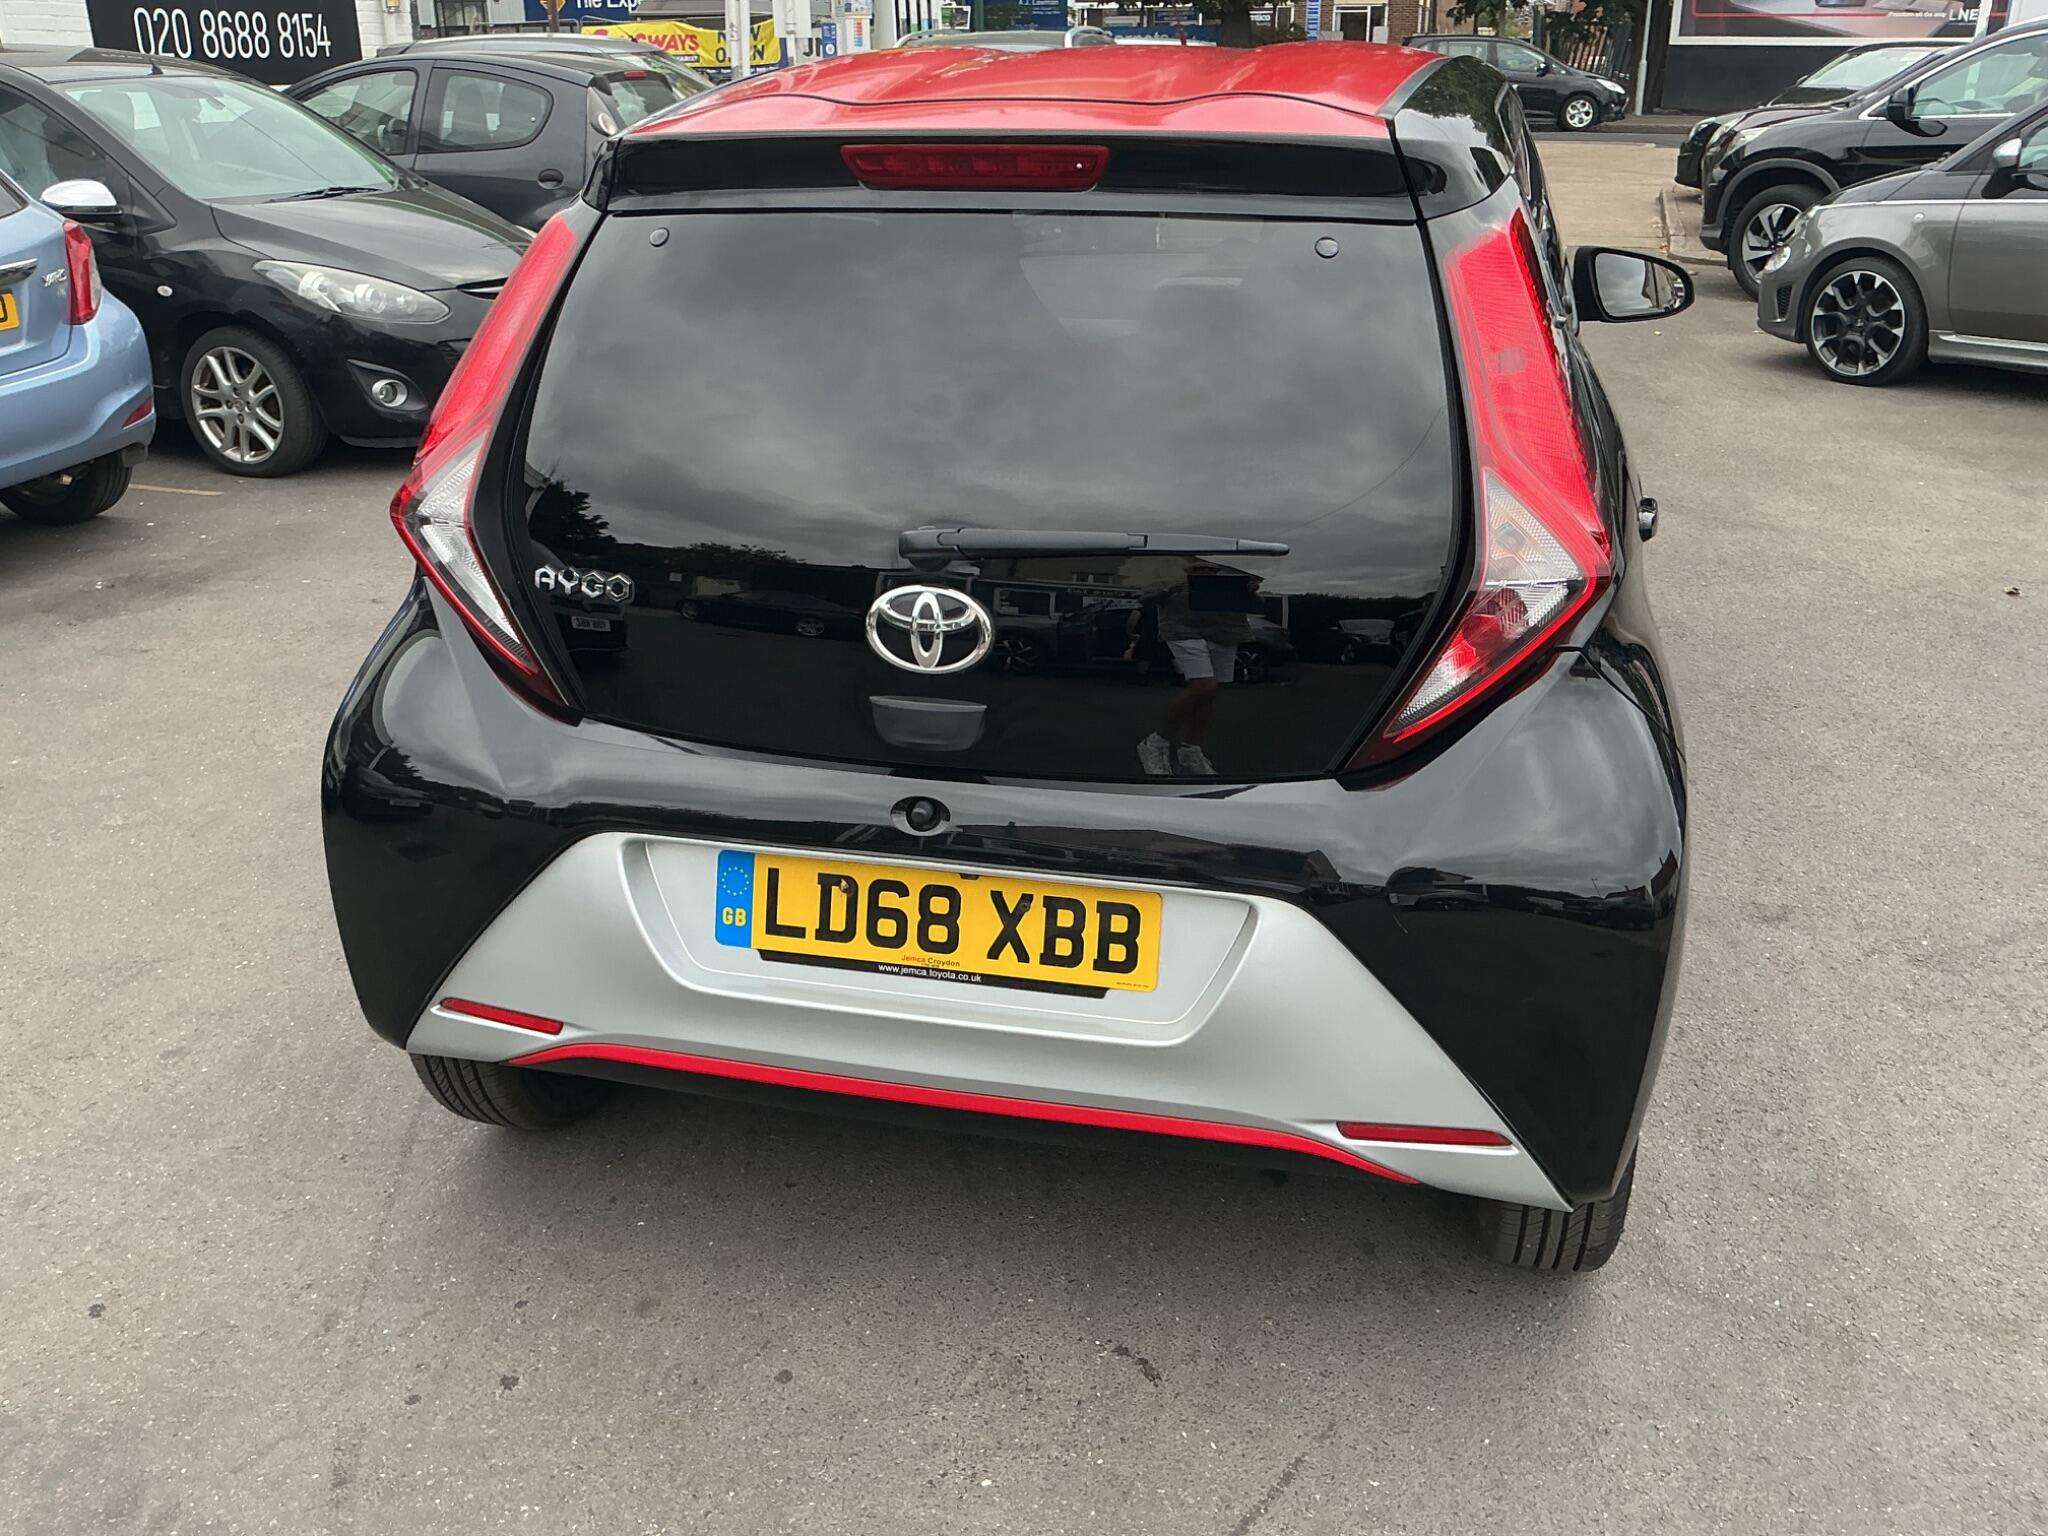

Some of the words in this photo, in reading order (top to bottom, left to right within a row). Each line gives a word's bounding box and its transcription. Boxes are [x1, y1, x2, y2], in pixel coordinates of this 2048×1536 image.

[1949, 8, 1978, 21] LNE
[133, 7, 192, 58] 020
[199, 9, 271, 59] 8688
[276, 11, 332, 59] 8154
[534, 564, 635, 603] AYGO
[721, 907, 747, 927] GB
[764, 867, 962, 955] LD68
[986, 889, 1142, 974] XBB
[901, 954, 926, 963] Jemca
[927, 957, 961, 967] Croydon
